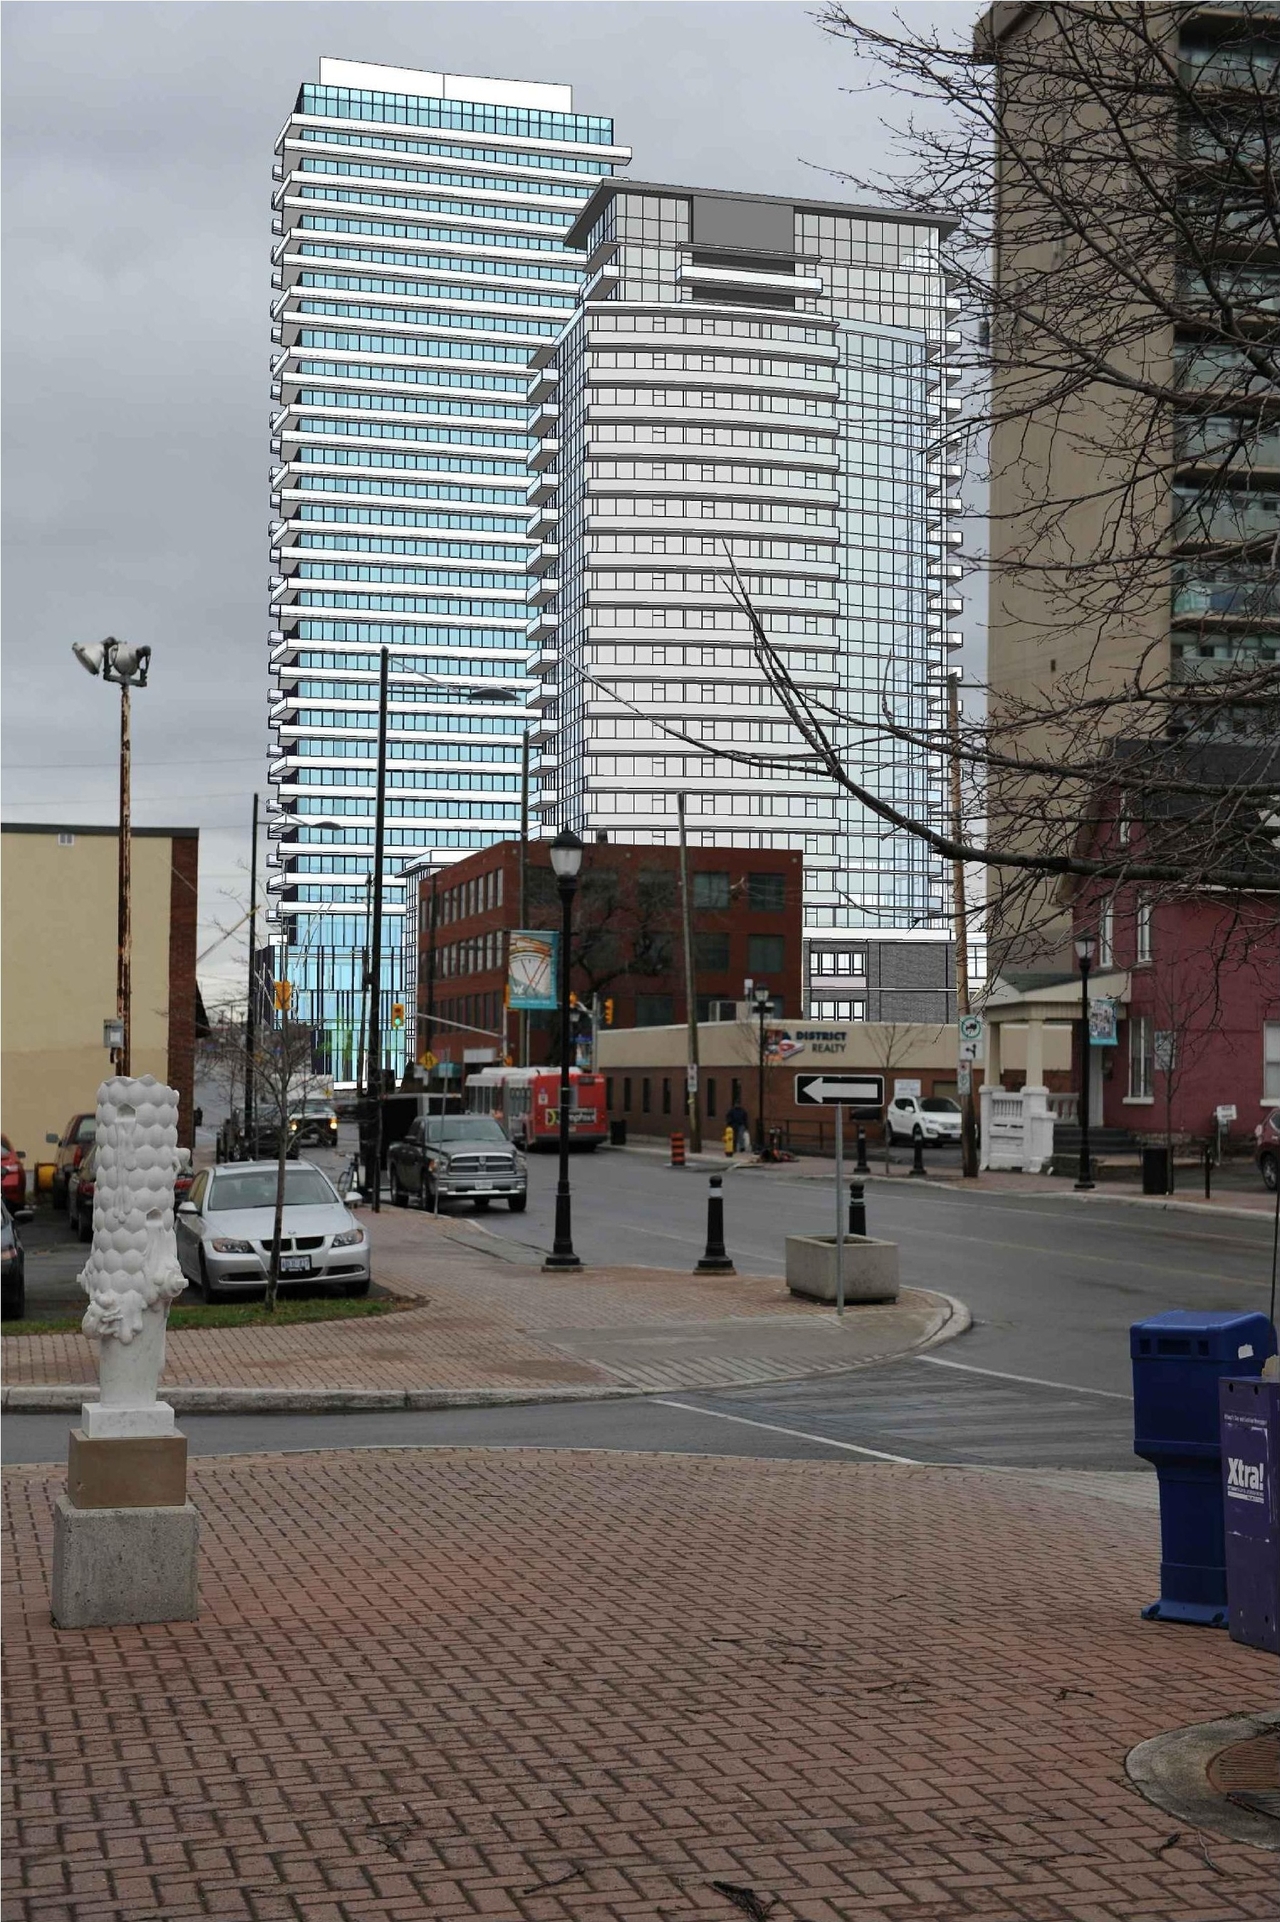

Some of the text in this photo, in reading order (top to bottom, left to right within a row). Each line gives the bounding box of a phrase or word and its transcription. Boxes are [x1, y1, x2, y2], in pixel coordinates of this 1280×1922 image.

[796, 1031, 847, 1040] DISTRICT
[812, 1043, 847, 1053] REALTY
[1227, 1457, 1264, 1490] Xtra!
